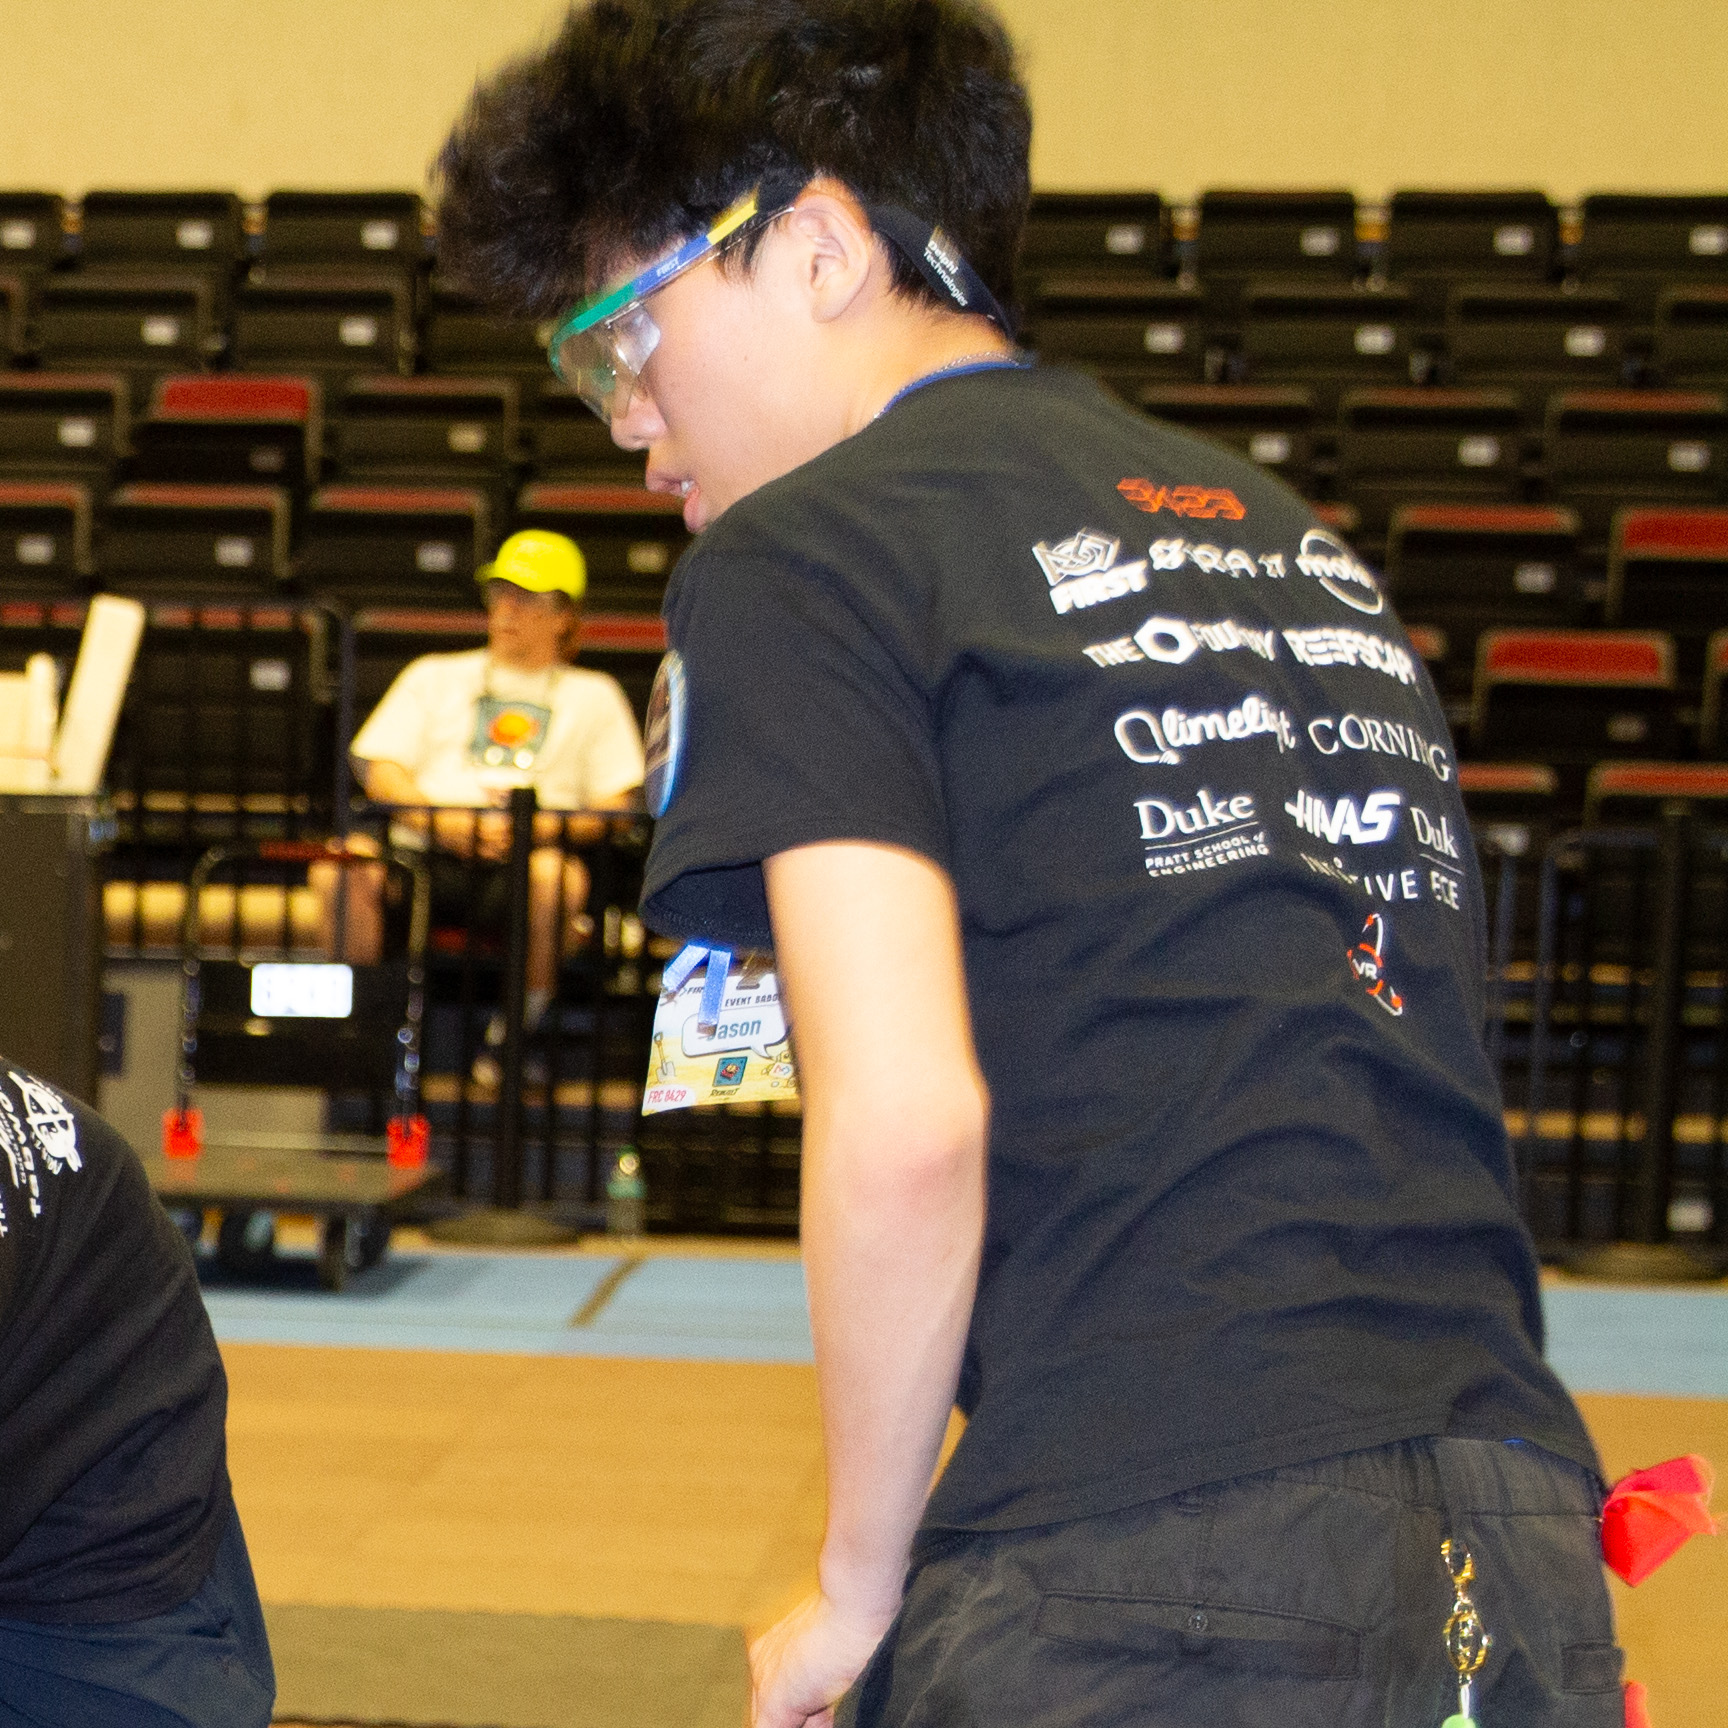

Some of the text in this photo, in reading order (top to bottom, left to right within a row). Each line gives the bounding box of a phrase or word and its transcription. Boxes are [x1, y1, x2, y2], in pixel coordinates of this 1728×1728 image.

[1049, 560, 1149, 614] FIRST
[1082, 636, 1144, 667] THE
[1134, 789, 1256, 840] Duke
[1285, 789, 1401, 845] HAAS
[1409, 806, 1460, 860] Duk
[1145, 852, 1190, 870] PRATT
[1194, 835, 1250, 860] SCHOOL
[1148, 844, 1271, 878] ENGINEERING
[1351, 958, 1379, 981] VR
[724, 997, 752, 1008] EVENT
[648, 1089, 687, 1104] FRC 8429
